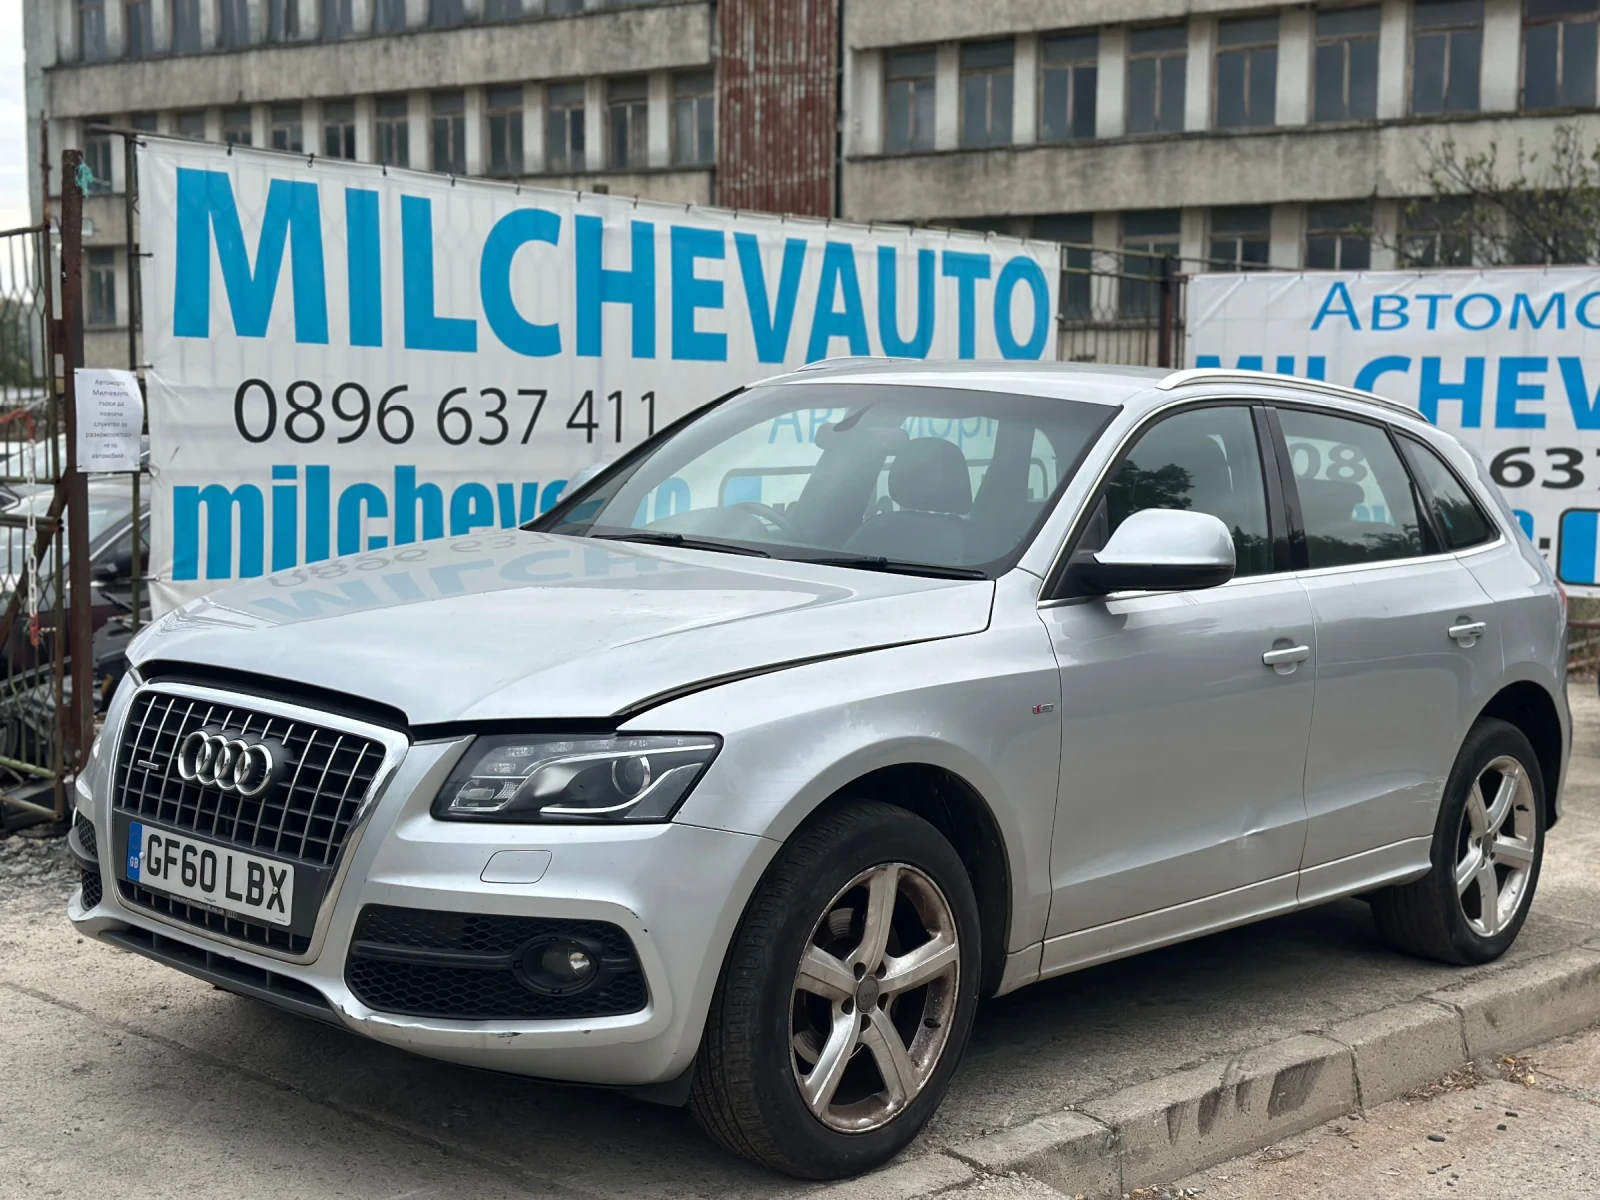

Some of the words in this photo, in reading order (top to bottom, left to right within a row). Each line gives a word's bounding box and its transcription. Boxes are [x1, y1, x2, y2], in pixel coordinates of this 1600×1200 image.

[173, 166, 1050, 364] MILCHEVAUTO
[234, 378, 414, 444] 0896
[436, 387, 547, 445] 637
[566, 390, 655, 444] 411
[1490, 446, 1600, 489] 63
[129, 856, 139, 869] GB
[147, 833, 217, 894] GF60
[225, 855, 288, 914] LBX
